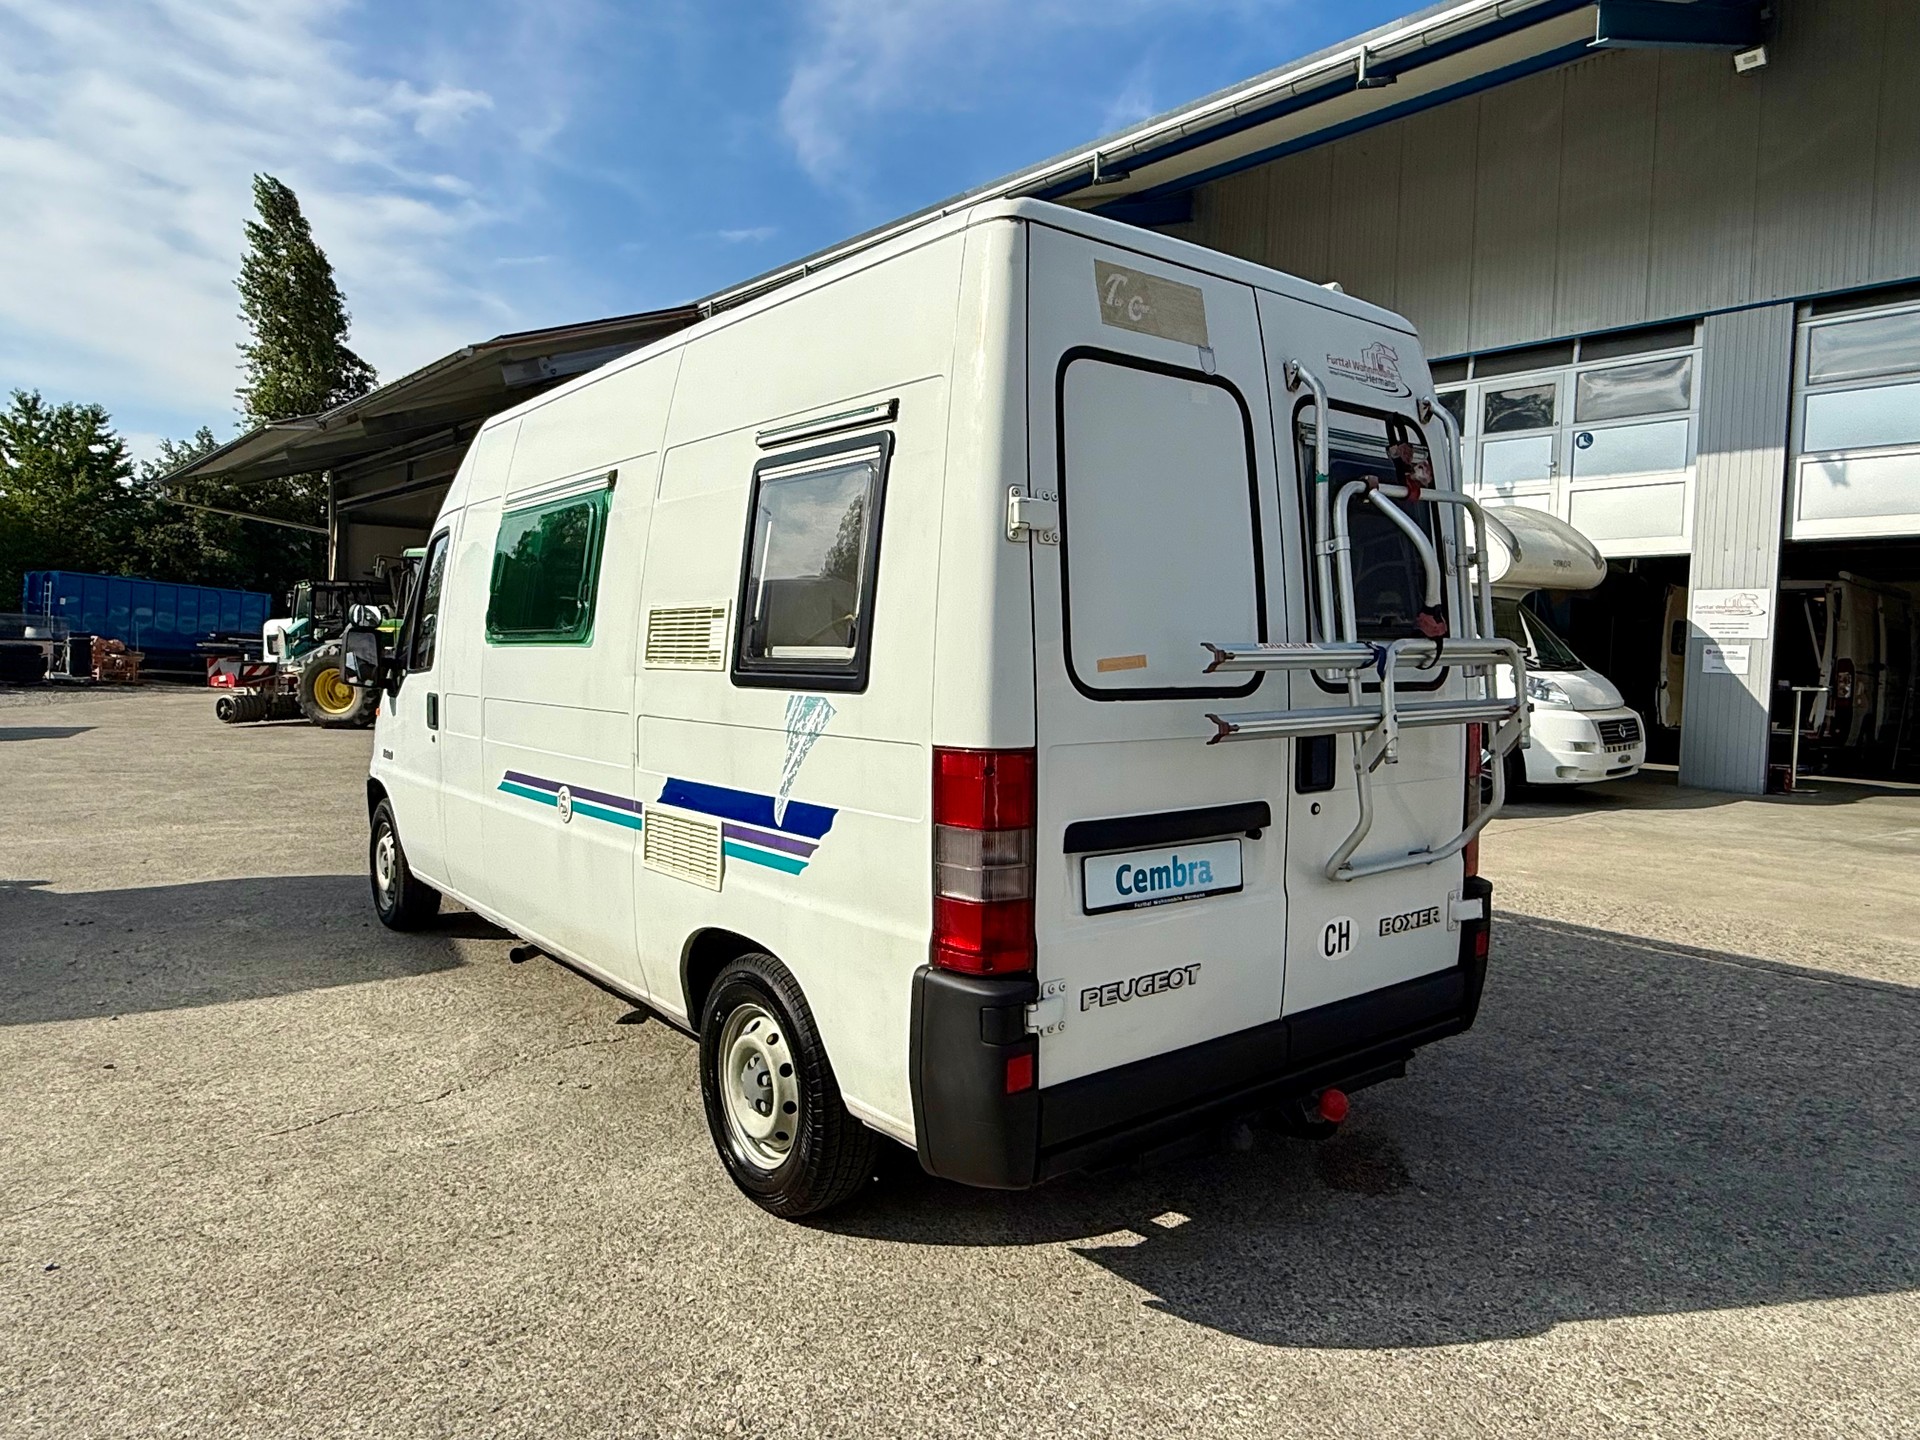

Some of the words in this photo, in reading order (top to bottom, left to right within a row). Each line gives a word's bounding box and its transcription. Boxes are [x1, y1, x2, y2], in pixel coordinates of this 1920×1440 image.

[1115, 854, 1213, 896] Cembra
[1324, 919, 1350, 957] CH
[1378, 905, 1441, 937] BOXER
[1080, 962, 1202, 1012] PEUGEOT
